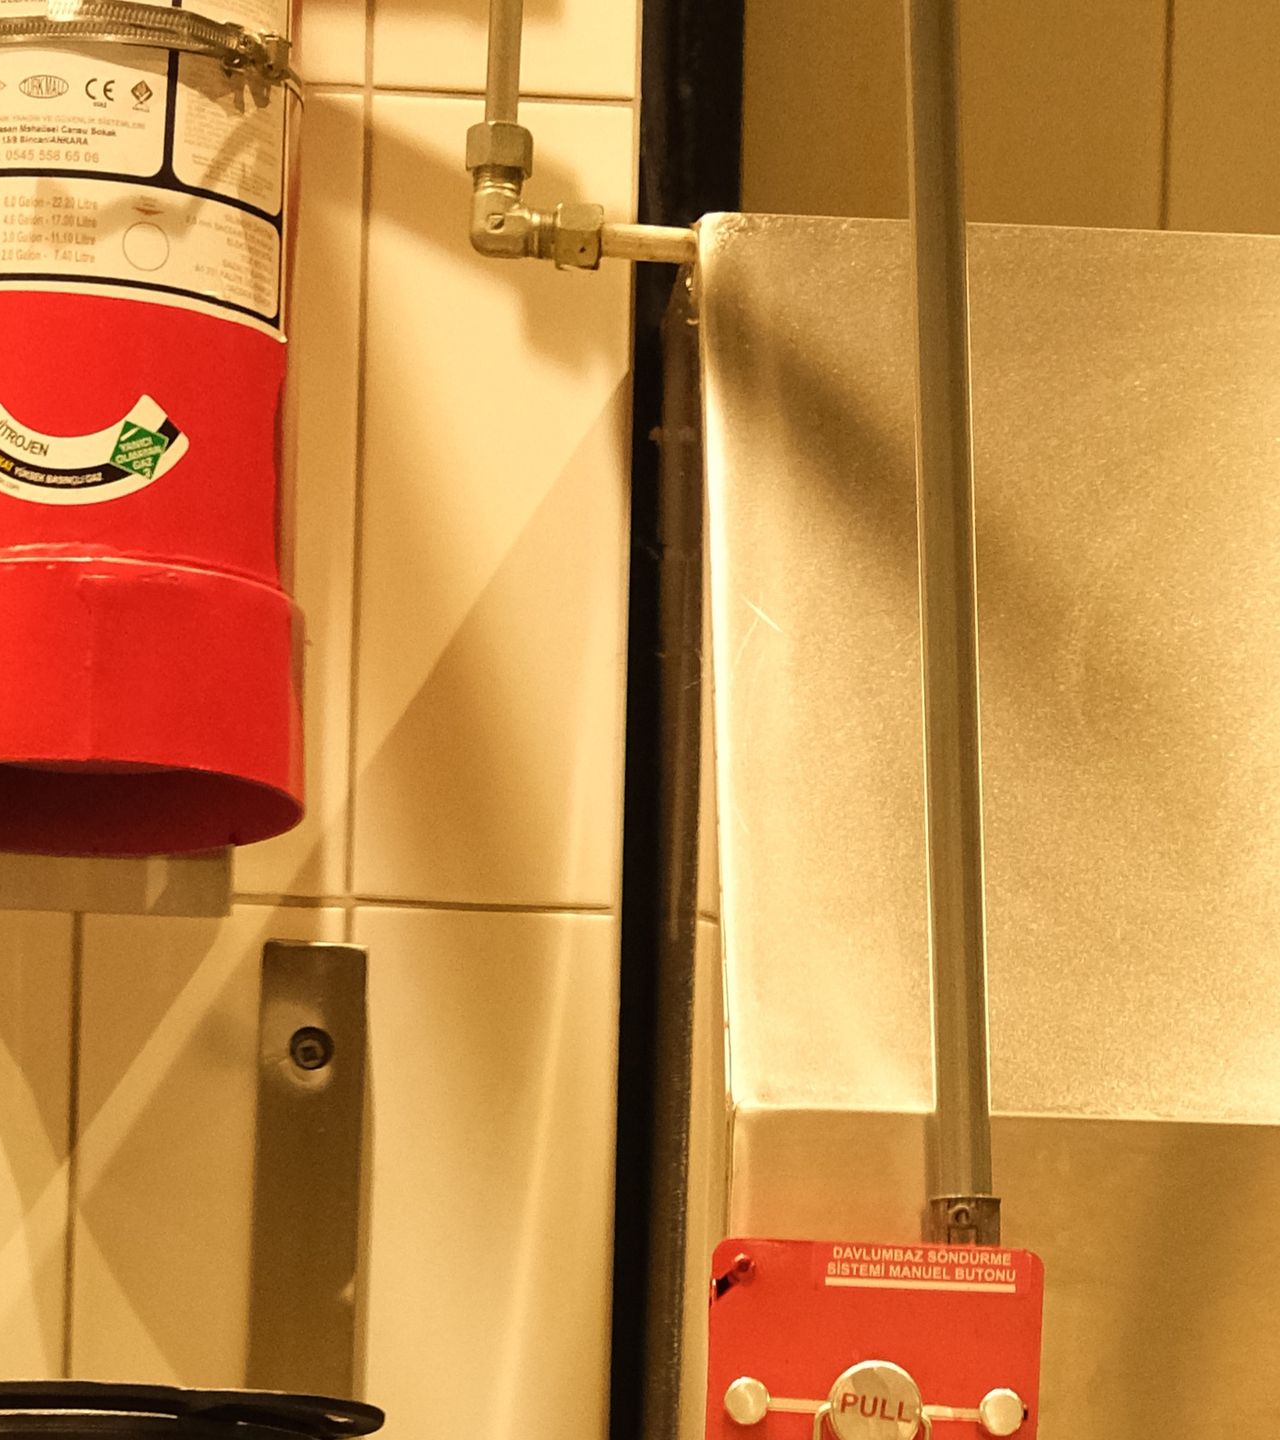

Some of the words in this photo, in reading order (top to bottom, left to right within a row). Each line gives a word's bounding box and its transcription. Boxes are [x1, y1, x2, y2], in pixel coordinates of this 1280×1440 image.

[832, 1246, 923, 1263] DAVLUMBAZ
[927, 1249, 1012, 1266] SÖNDÜRME
[827, 1262, 885, 1277] SİSTEMİ
[889, 1264, 951, 1280] MANUEL
[955, 1267, 1016, 1282] BUTONU
[839, 1392, 913, 1424] PULL
